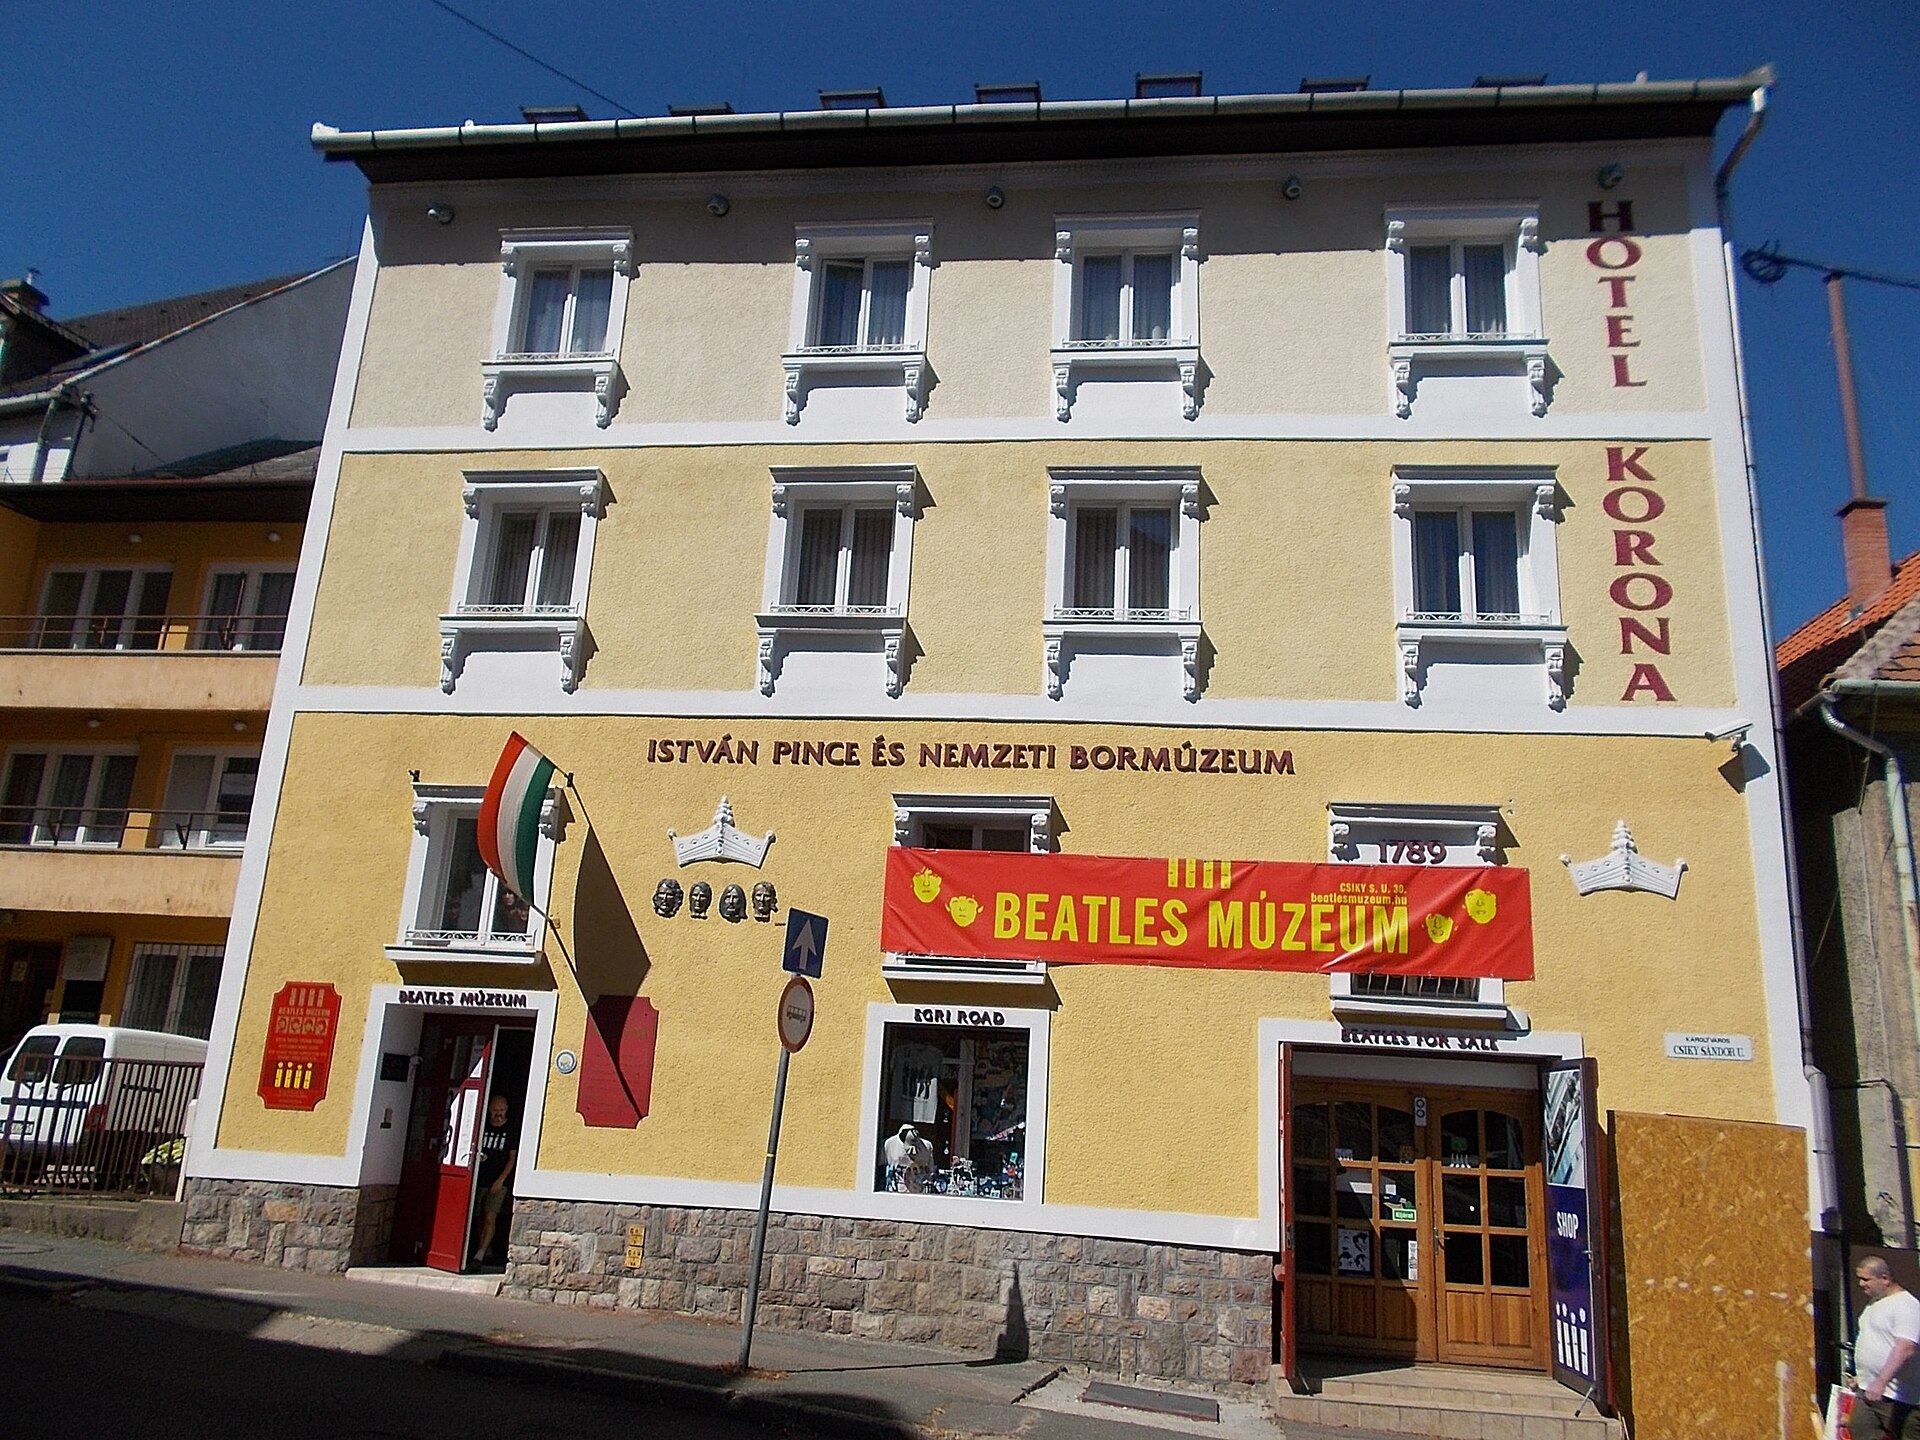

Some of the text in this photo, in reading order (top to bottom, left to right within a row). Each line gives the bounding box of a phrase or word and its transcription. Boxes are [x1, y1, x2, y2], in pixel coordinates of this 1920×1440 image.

[1586, 200, 1648, 388] HOTEL
[1601, 446, 1679, 703] KORONA
[647, 733, 1296, 775] ISTVÁN PINCE ÉS NEMZETI BORMÚZEUM
[1379, 839, 1447, 864] 1789
[1311, 892, 1408, 905] beatlesmuzeum.hu
[1340, 882, 1408, 894] CSIKY S. U. 30.
[993, 890, 1410, 955] BEATLES MÚZEUM
[398, 989, 527, 1008] BEATLES MÚZEUM
[914, 1008, 1005, 1026] EGRI ROAD
[1341, 1027, 1500, 1052] BEATLES FOR SALE
[1673, 1044, 1699, 1056] CSIKY
[1556, 1210, 1579, 1241] SHOP
